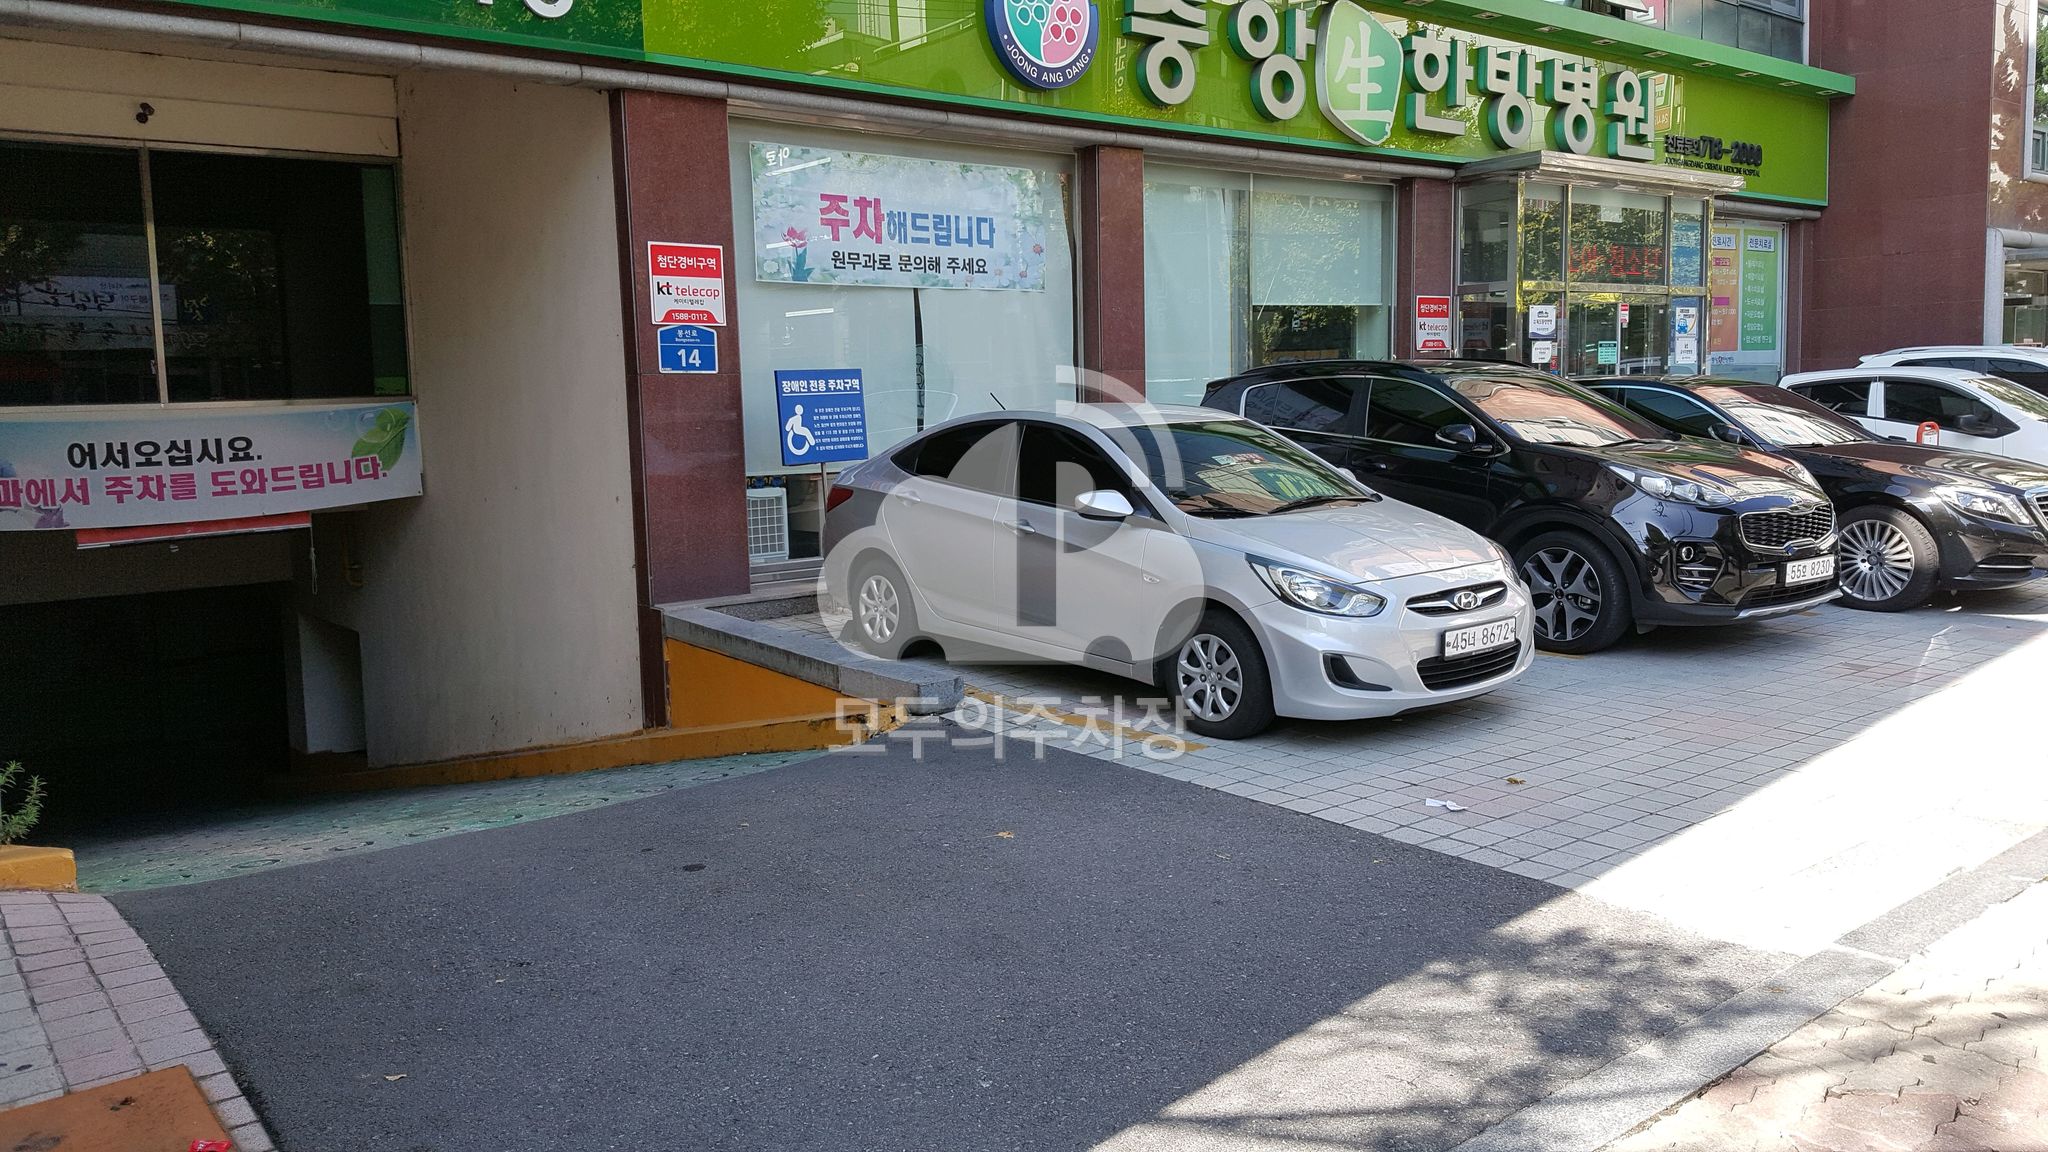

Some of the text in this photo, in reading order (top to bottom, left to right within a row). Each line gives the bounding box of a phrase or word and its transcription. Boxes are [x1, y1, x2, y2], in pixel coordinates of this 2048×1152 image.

[1006, 43, 1090, 83] JOONG ANG DANG
[1125, 0, 1317, 121] 중앙
[1404, 28, 1656, 161] 한방병원
[818, 192, 996, 249] 주차해드립니다
[657, 254, 717, 271] 첨단경비구역
[831, 250, 988, 275] 원무과로 문의해 주세요
[657, 281, 720, 300] kt telecop
[671, 312, 708, 321] 1588-0112
[676, 329, 698, 338] 봉선로
[1418, 321, 1448, 333] kt telecop
[677, 348, 702, 368] 14
[782, 378, 860, 393] 장애인 전용 주차구역
[67, 435, 263, 471] 어서오십시요.
[104, 473, 199, 504] 주차를
[211, 455, 388, 498] 도와드립니다.
[1810, 559, 1831, 576] 8230
[1451, 622, 1510, 652] 45너 8672
